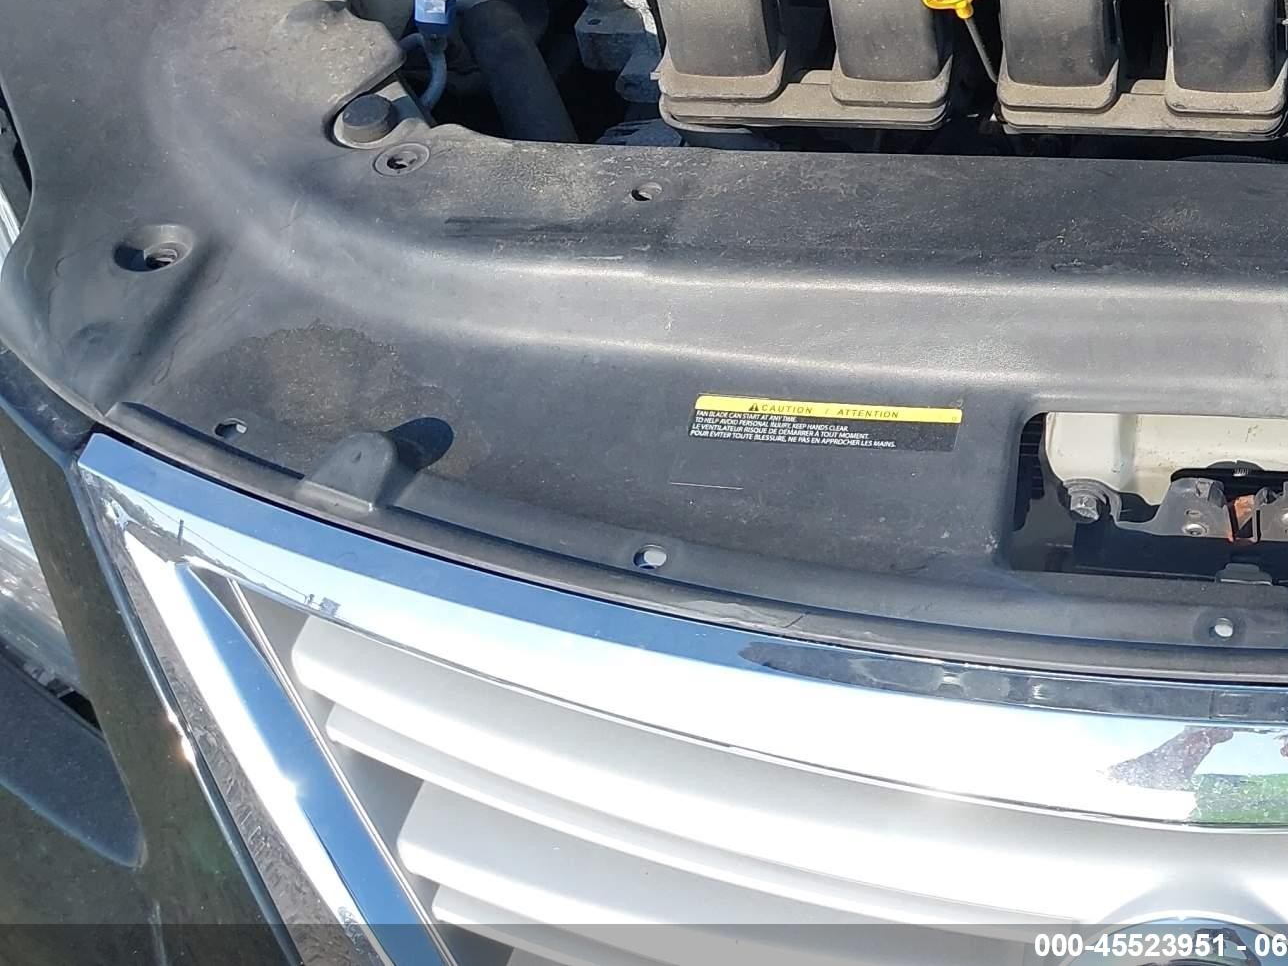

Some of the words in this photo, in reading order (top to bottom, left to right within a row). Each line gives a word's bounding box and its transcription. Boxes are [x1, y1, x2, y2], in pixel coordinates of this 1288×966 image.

[709, 411, 728, 419] BLADE
[761, 404, 813, 414] CAUTION
[837, 409, 900, 419] ATTENTION
[701, 424, 744, 433] VENTILATEUR
[743, 426, 768, 434] RISQUE
[820, 431, 839, 439] TOUT
[739, 420, 770, 428] PERSONAL
[690, 429, 710, 437] POUR
[732, 432, 754, 440] TOUTE
[820, 438, 861, 446] APPROCHER
